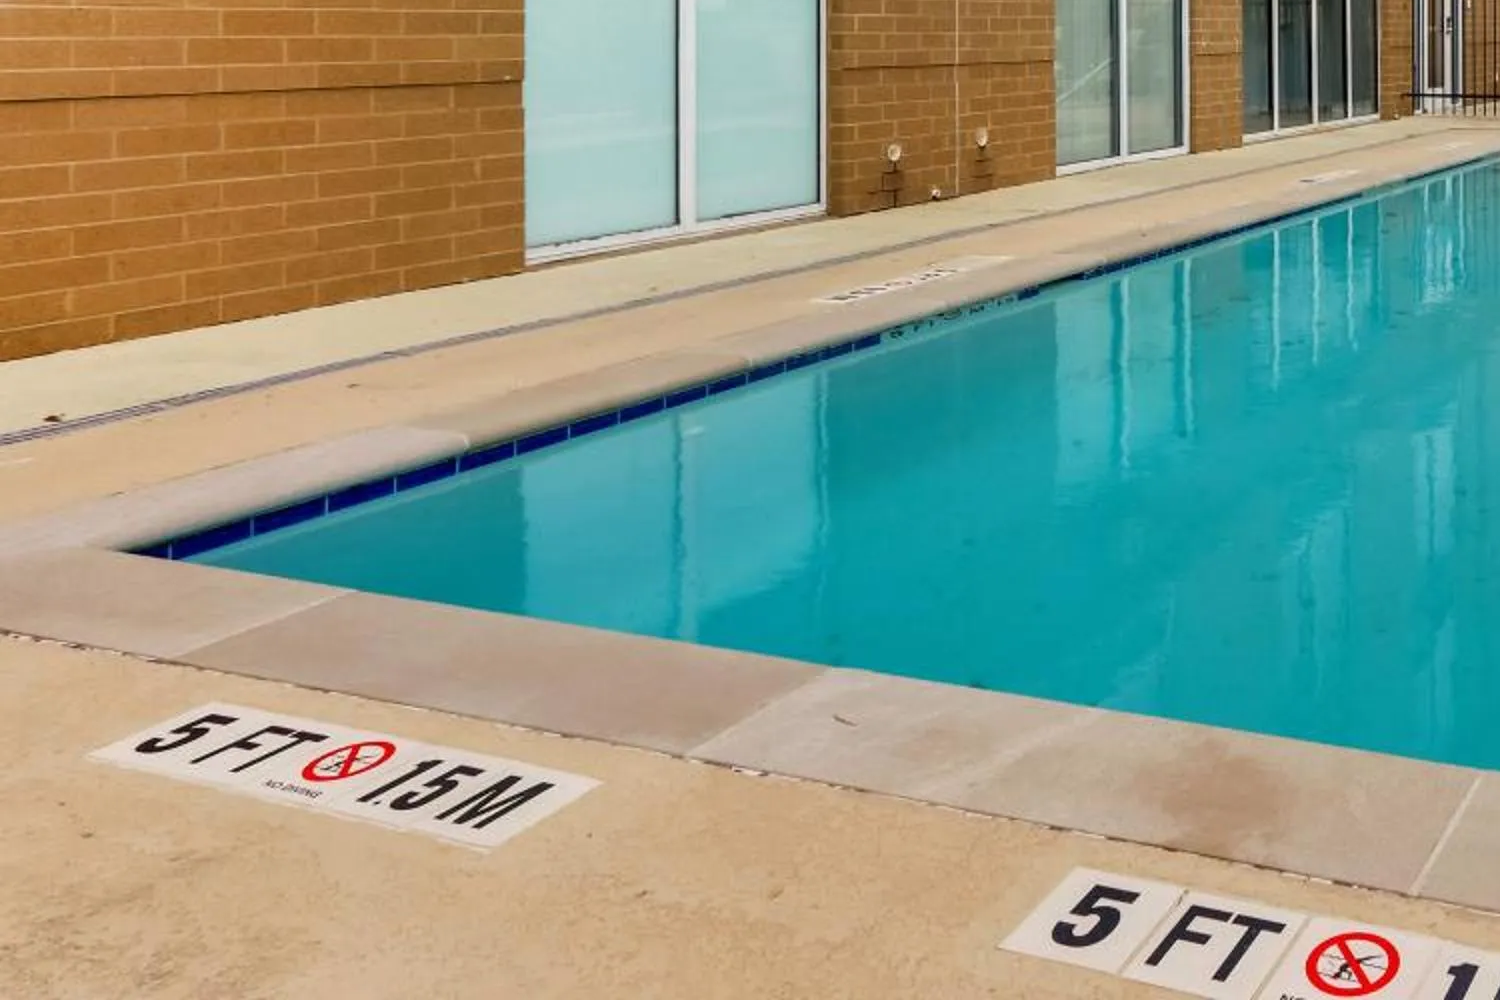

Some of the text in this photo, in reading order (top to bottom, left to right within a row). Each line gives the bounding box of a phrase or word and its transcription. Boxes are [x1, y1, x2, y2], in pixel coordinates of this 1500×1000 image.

[135, 713, 239, 753] 5
[189, 725, 331, 773] FT
[1051, 884, 1141, 948] 5
[1145, 904, 1287, 982] FT
